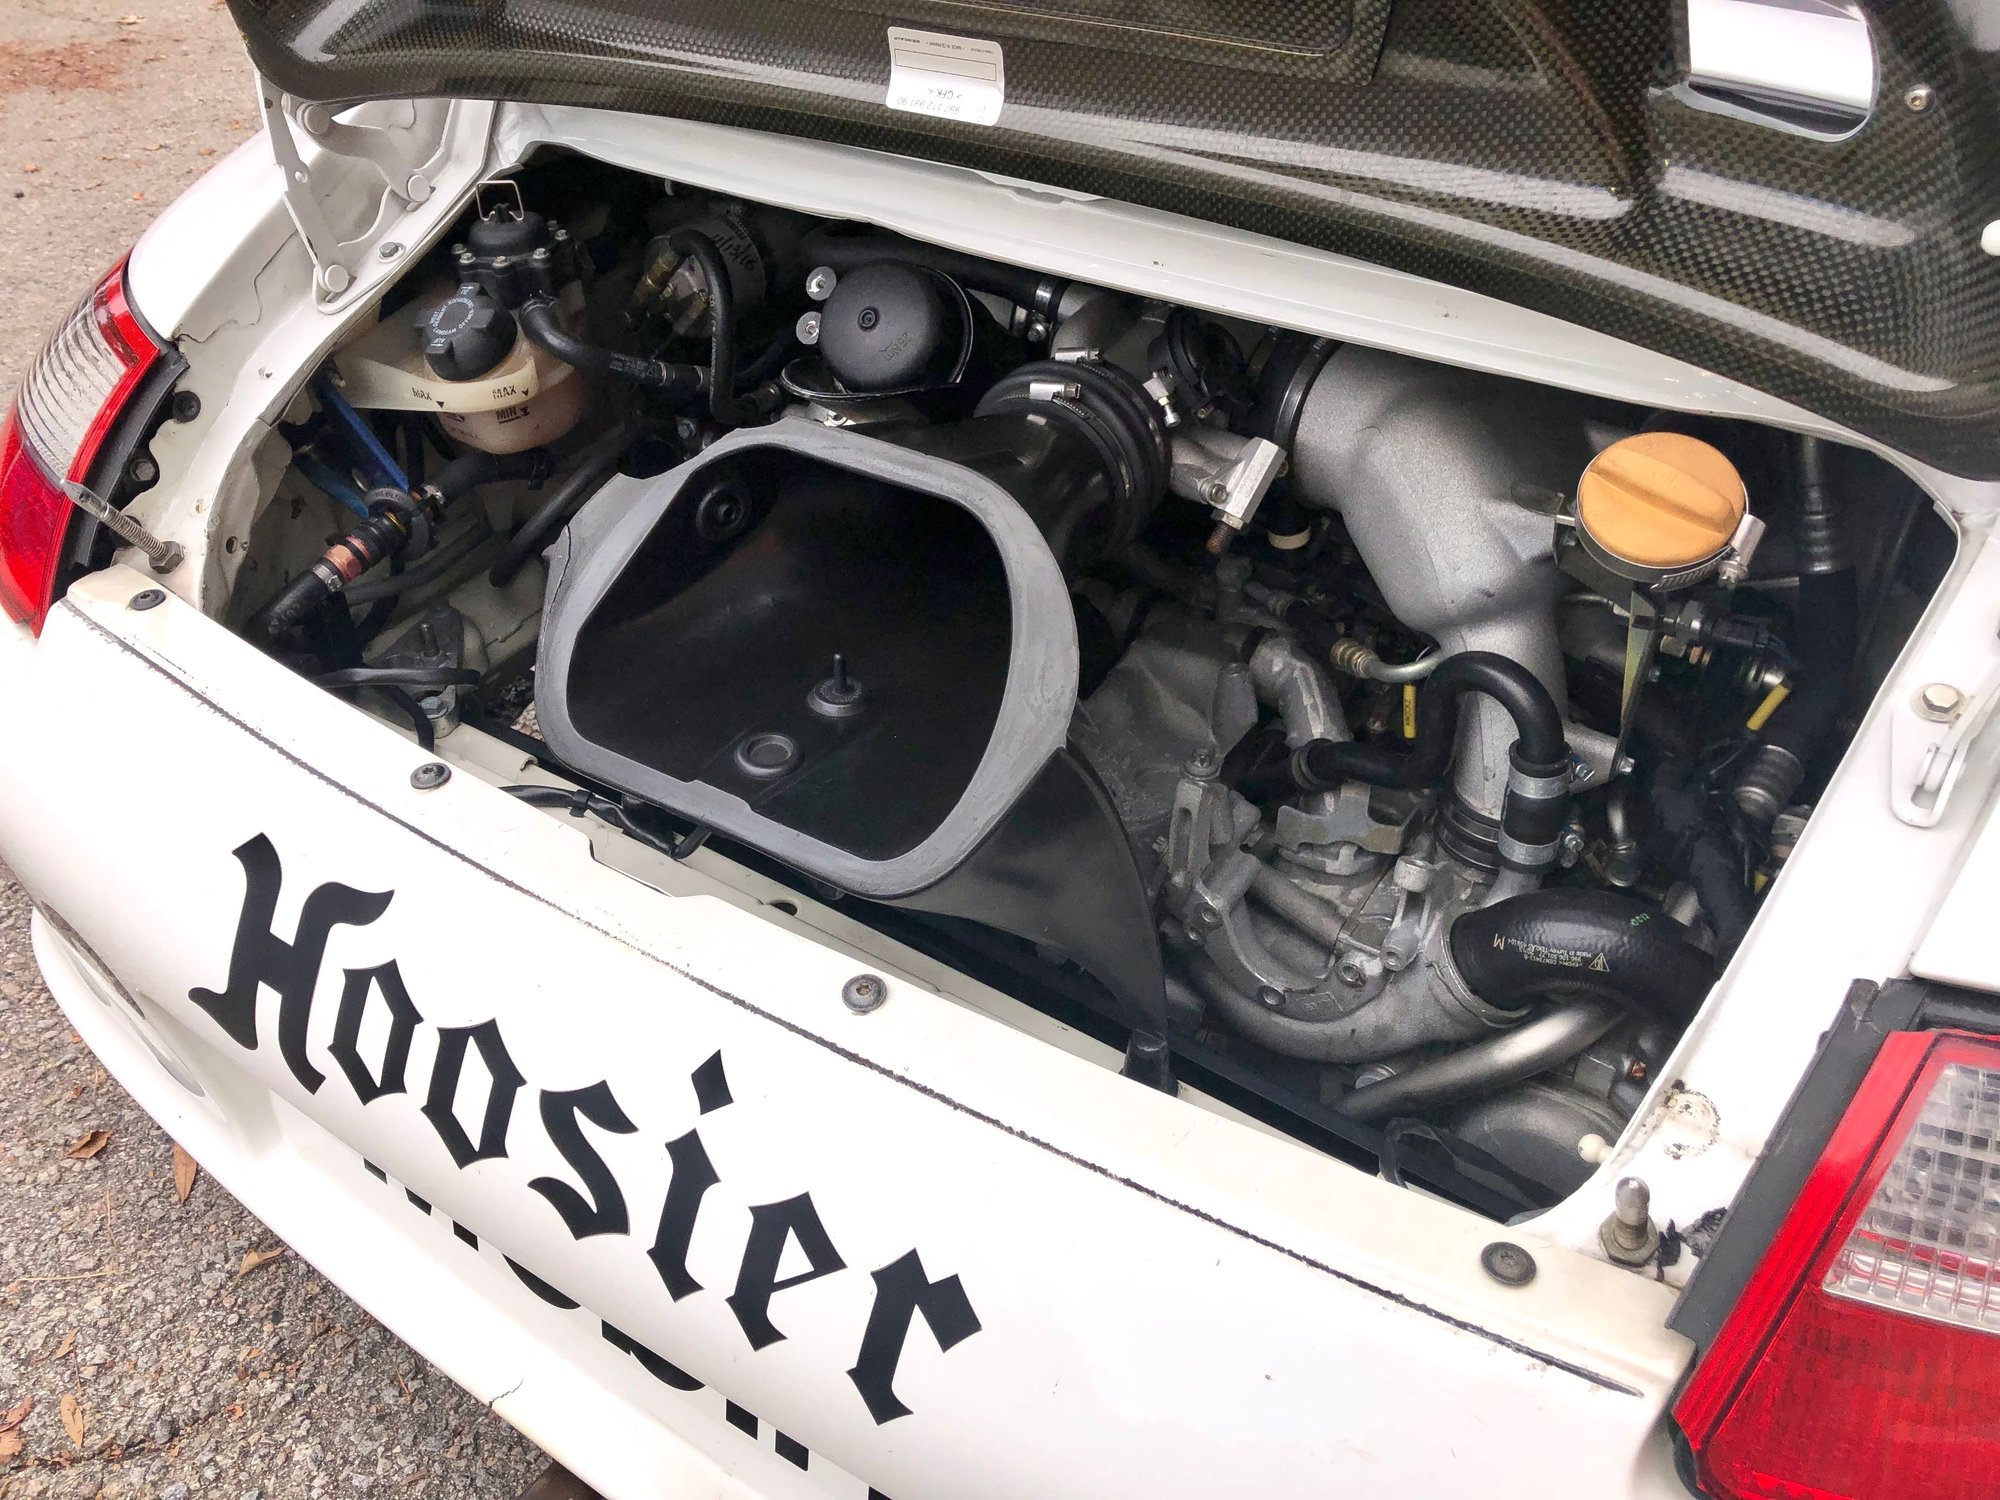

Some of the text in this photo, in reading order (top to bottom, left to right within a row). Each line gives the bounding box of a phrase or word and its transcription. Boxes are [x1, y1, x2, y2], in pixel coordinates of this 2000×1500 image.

[937, 88, 954, 100] CFK
[411, 387, 433, 401] MAX
[491, 385, 517, 400] MAX
[495, 406, 518, 421] MIN
[187, 832, 983, 1427] Hoosier
